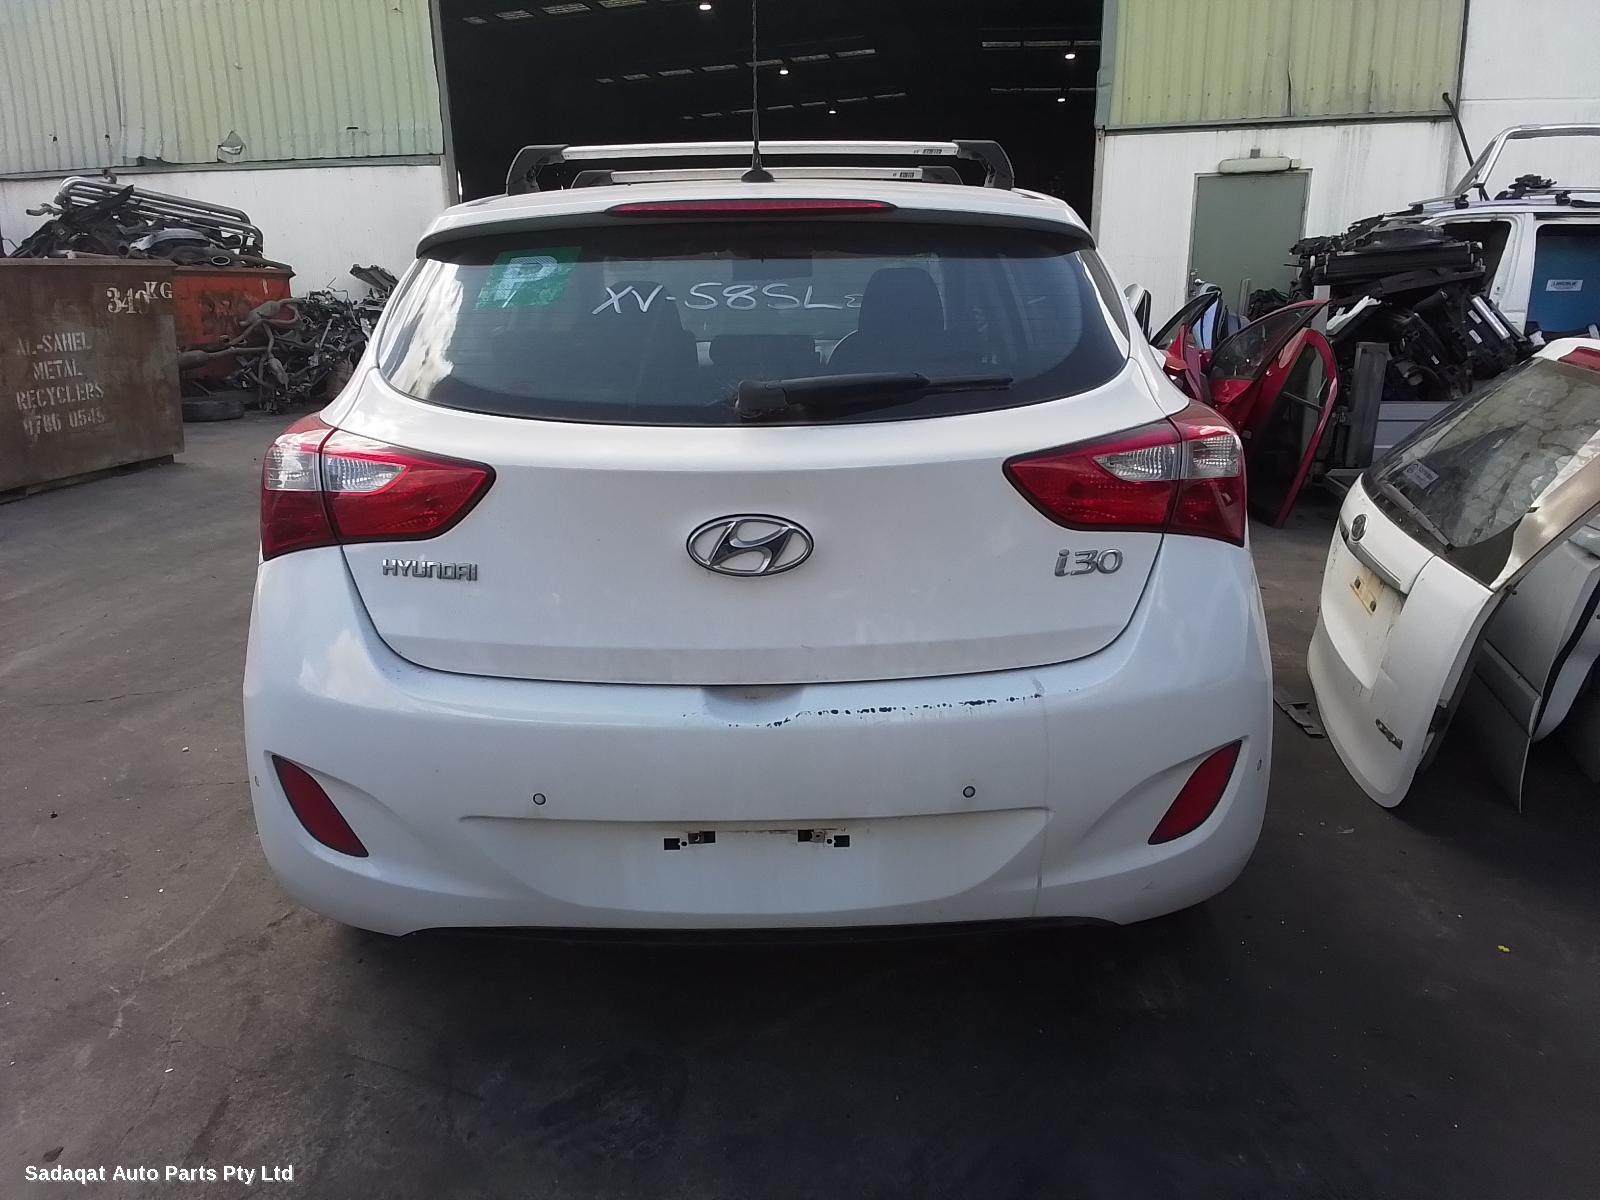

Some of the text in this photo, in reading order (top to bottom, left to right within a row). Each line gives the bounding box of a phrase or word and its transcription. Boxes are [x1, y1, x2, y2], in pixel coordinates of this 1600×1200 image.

[33, 359, 82, 380] METAL
[16, 382, 104, 410] RECYCLERS
[382, 559, 478, 581] HYUNDAI
[1054, 549, 1123, 577] i30
